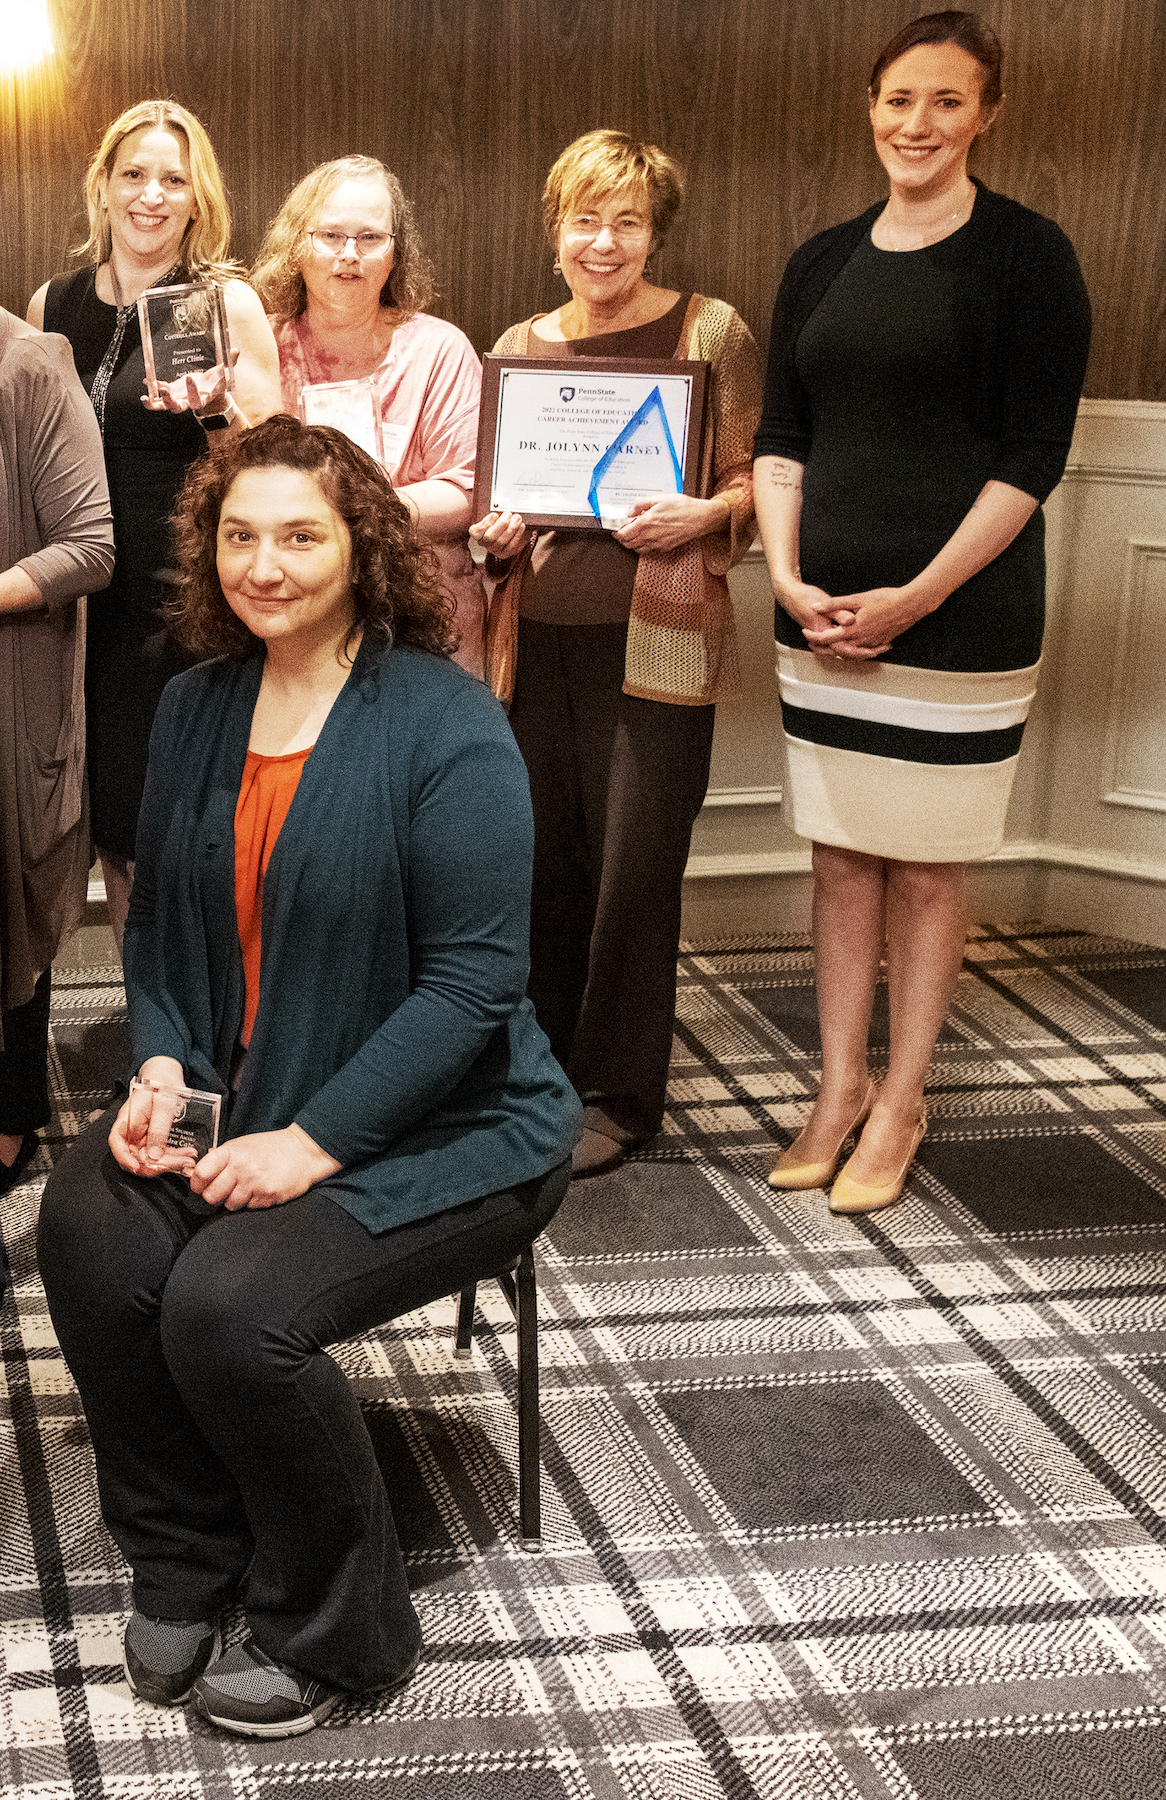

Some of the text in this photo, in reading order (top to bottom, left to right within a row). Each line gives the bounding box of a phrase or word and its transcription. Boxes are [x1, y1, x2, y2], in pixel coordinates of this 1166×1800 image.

[186, 355, 204, 363] Clinic
[578, 388, 616, 397] PennState
[568, 417, 619, 425] ACHIEVEMENT
[518, 440, 542, 451] DR.
[546, 442, 600, 454] JOLYNN
